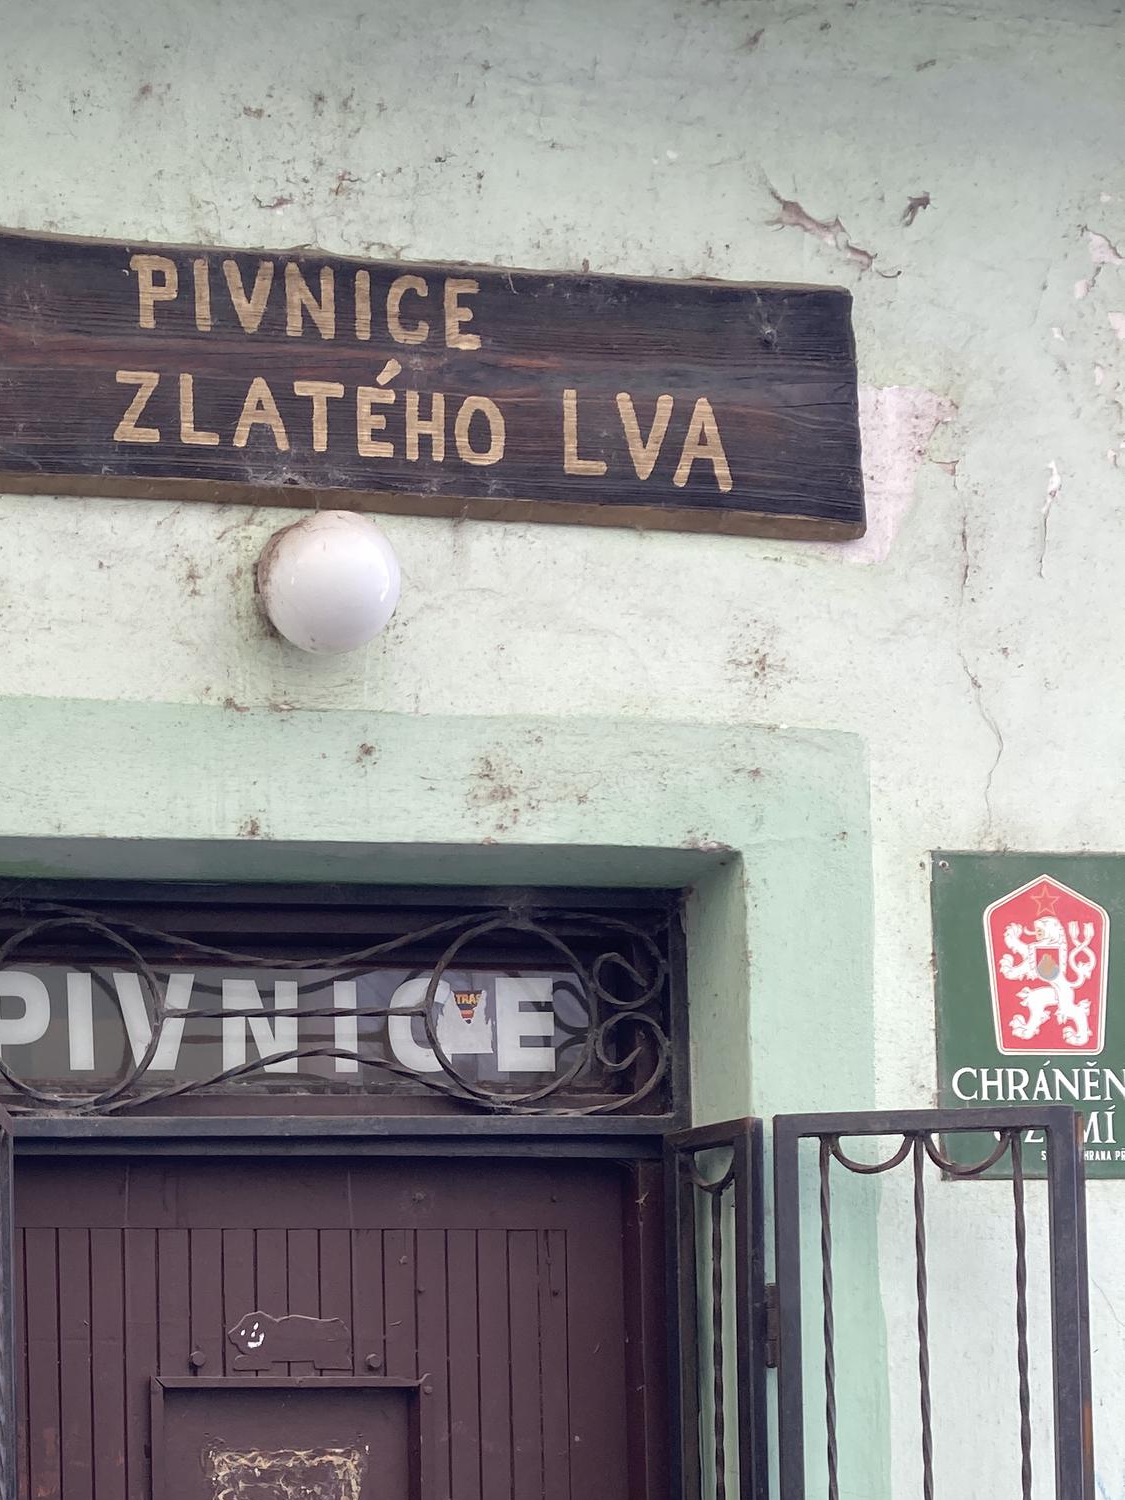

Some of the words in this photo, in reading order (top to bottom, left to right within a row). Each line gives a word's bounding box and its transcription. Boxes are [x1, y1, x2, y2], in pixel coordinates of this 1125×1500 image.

[128, 253, 482, 350] PIVNICE
[112, 359, 506, 467] ZLATÉHO
[563, 388, 734, 494] LVA
